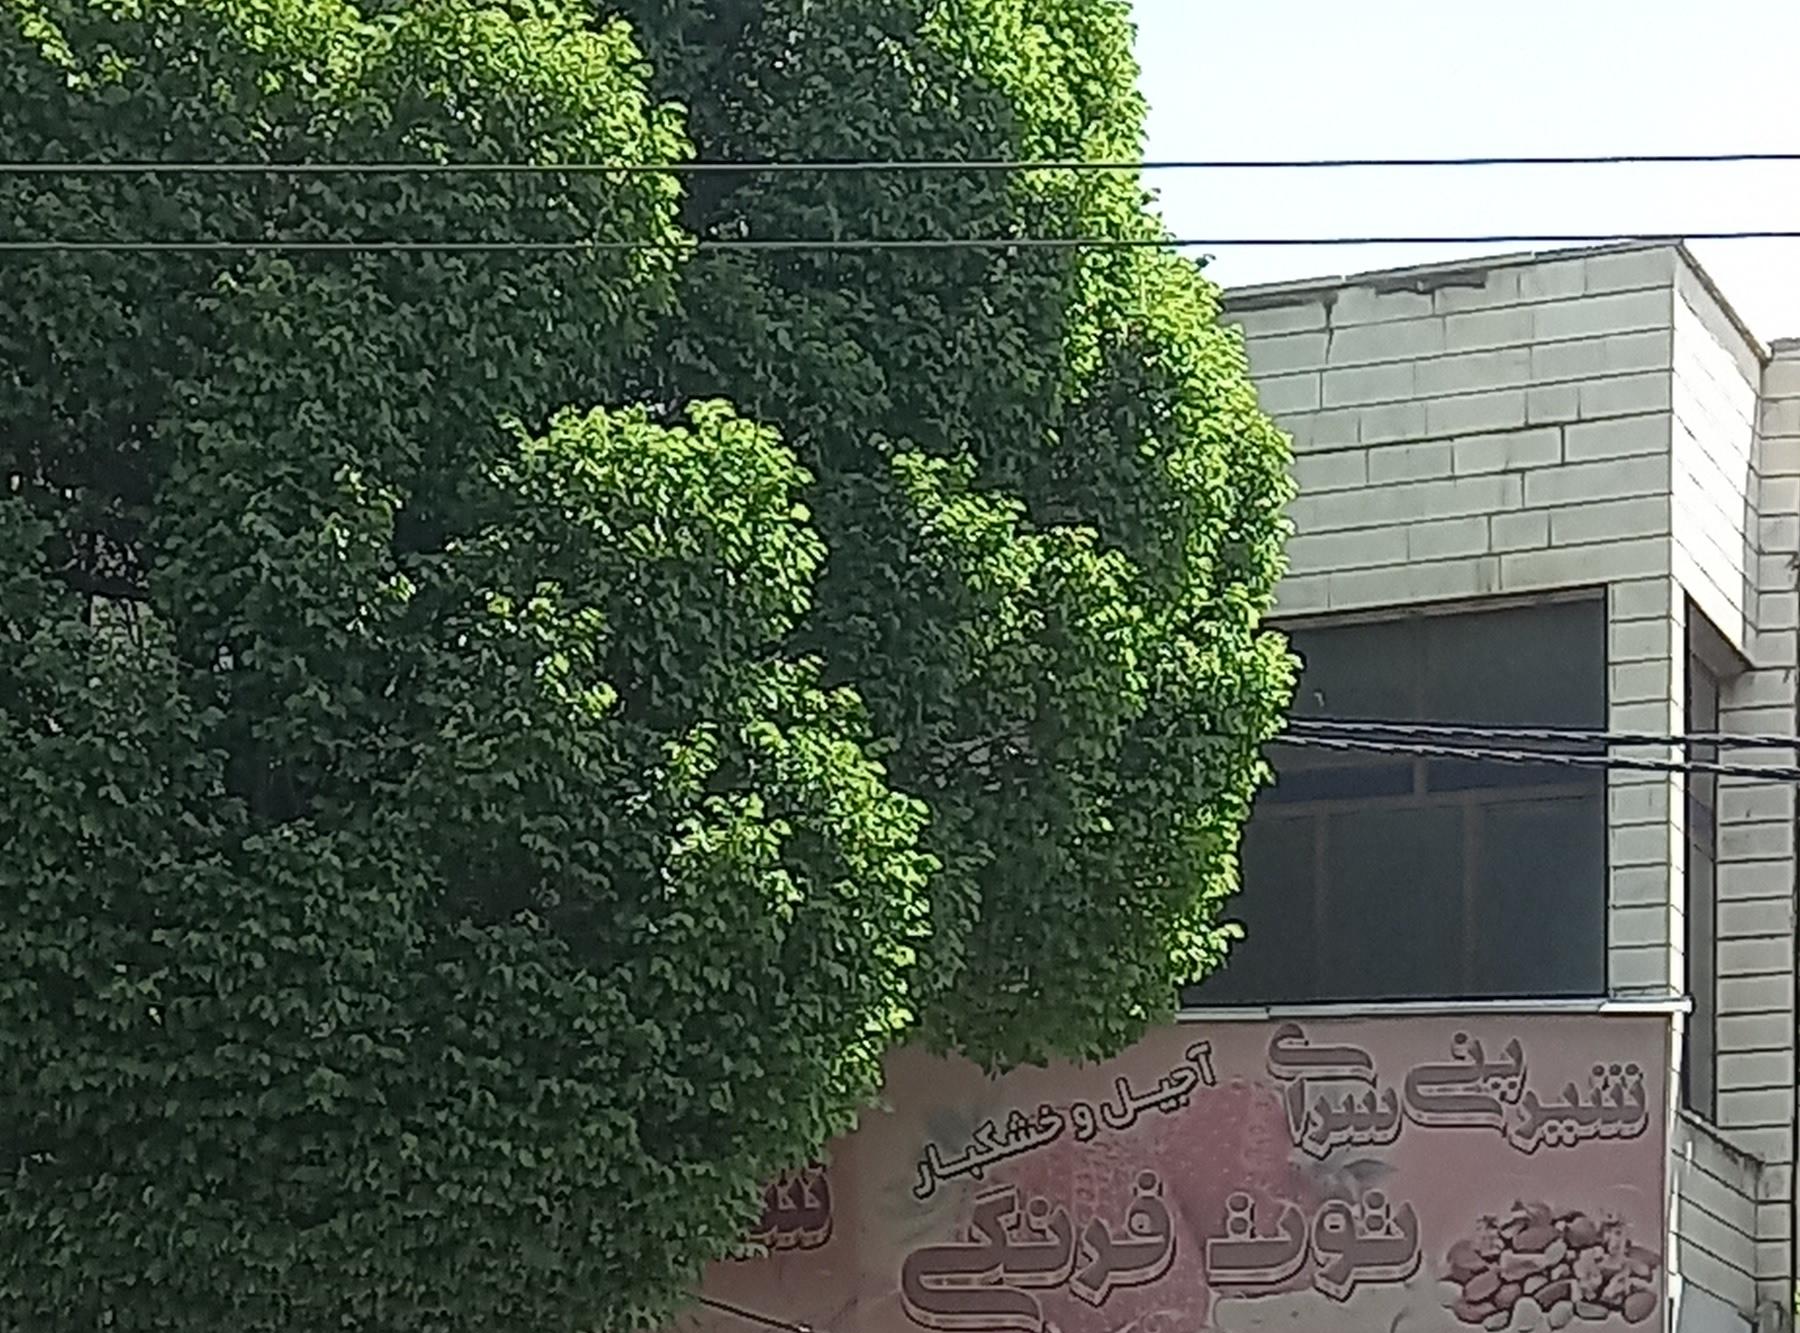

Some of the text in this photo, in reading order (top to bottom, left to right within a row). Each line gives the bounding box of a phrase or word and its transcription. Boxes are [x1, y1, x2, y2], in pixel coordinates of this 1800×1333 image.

[913, 1041, 1217, 1200] آجیل و خشکبار
[1267, 1023, 1648, 1160] شیرینی سرای
[1206, 1191, 1421, 1302] توت
